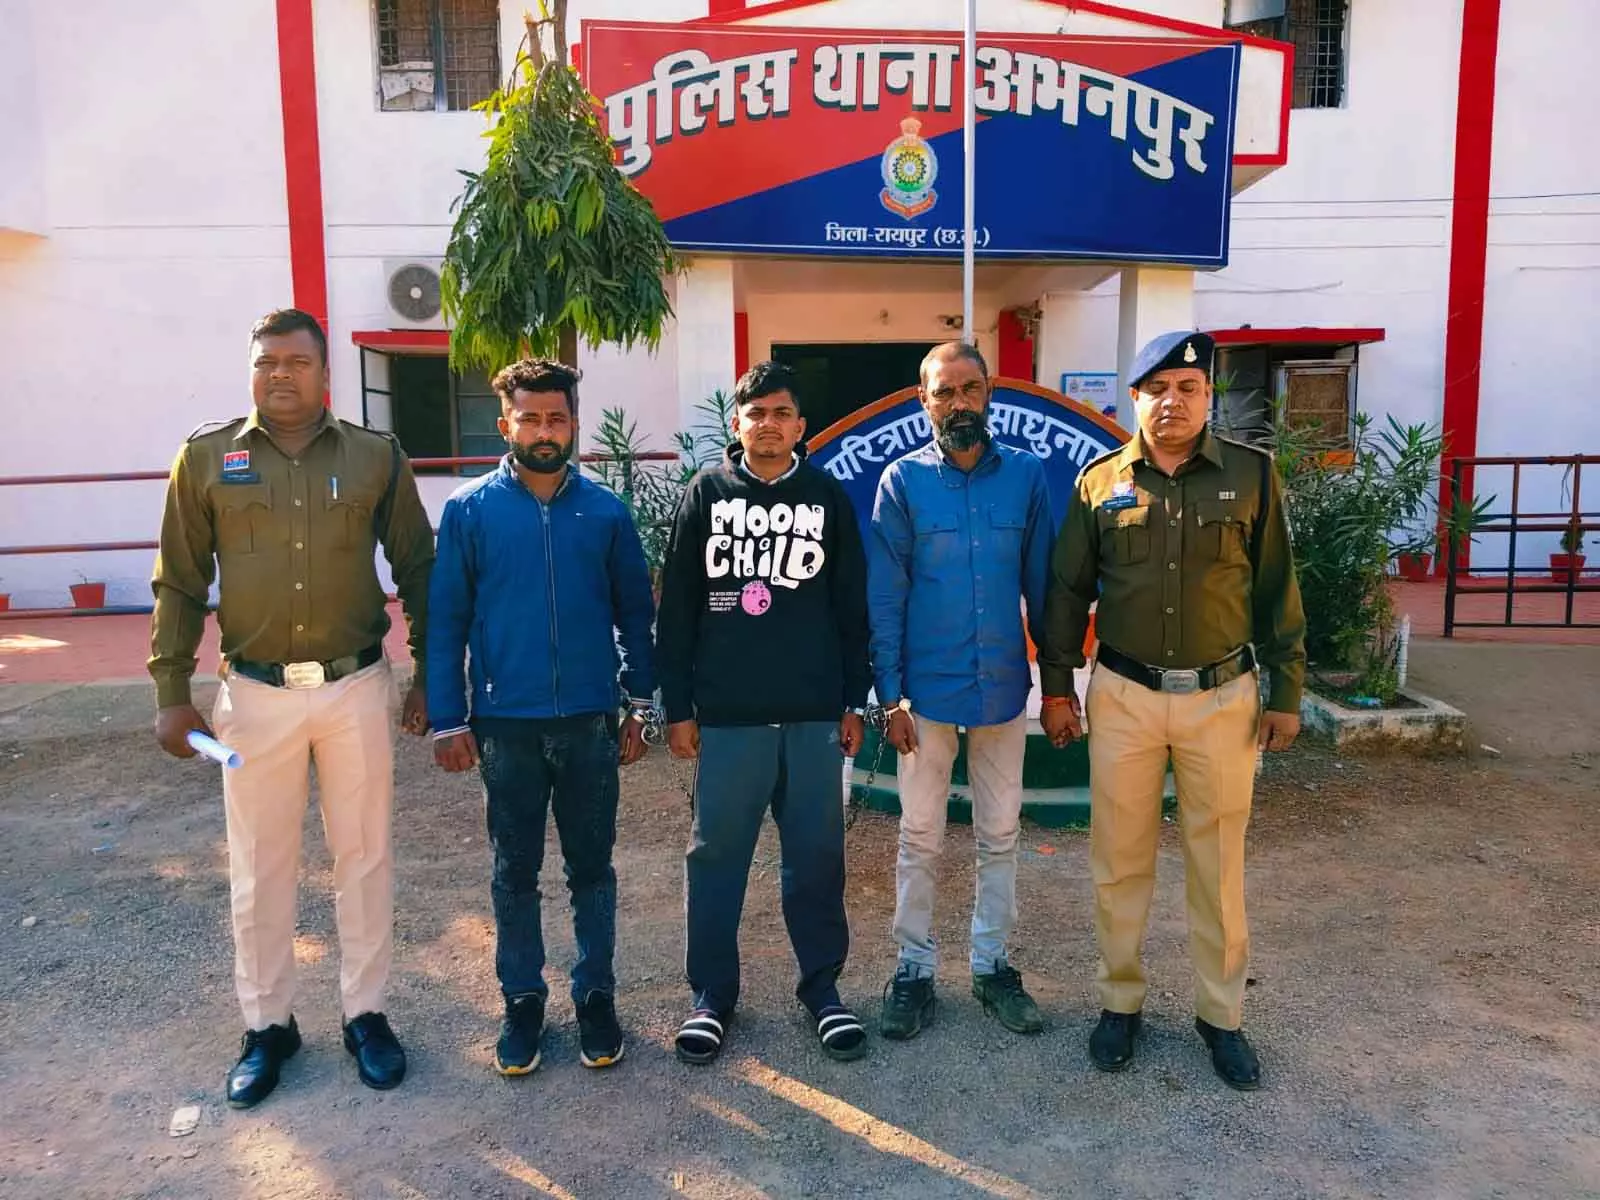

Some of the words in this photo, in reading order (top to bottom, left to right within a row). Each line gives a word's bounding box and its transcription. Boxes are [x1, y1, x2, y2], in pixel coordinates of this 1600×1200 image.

[604, 49, 798, 177] पुलिस
[813, 44, 961, 111] थाना
[974, 46, 1215, 181] अभनपुर
[825, 221, 928, 248] जिला-रायपुर
[711, 498, 825, 541] MOON
